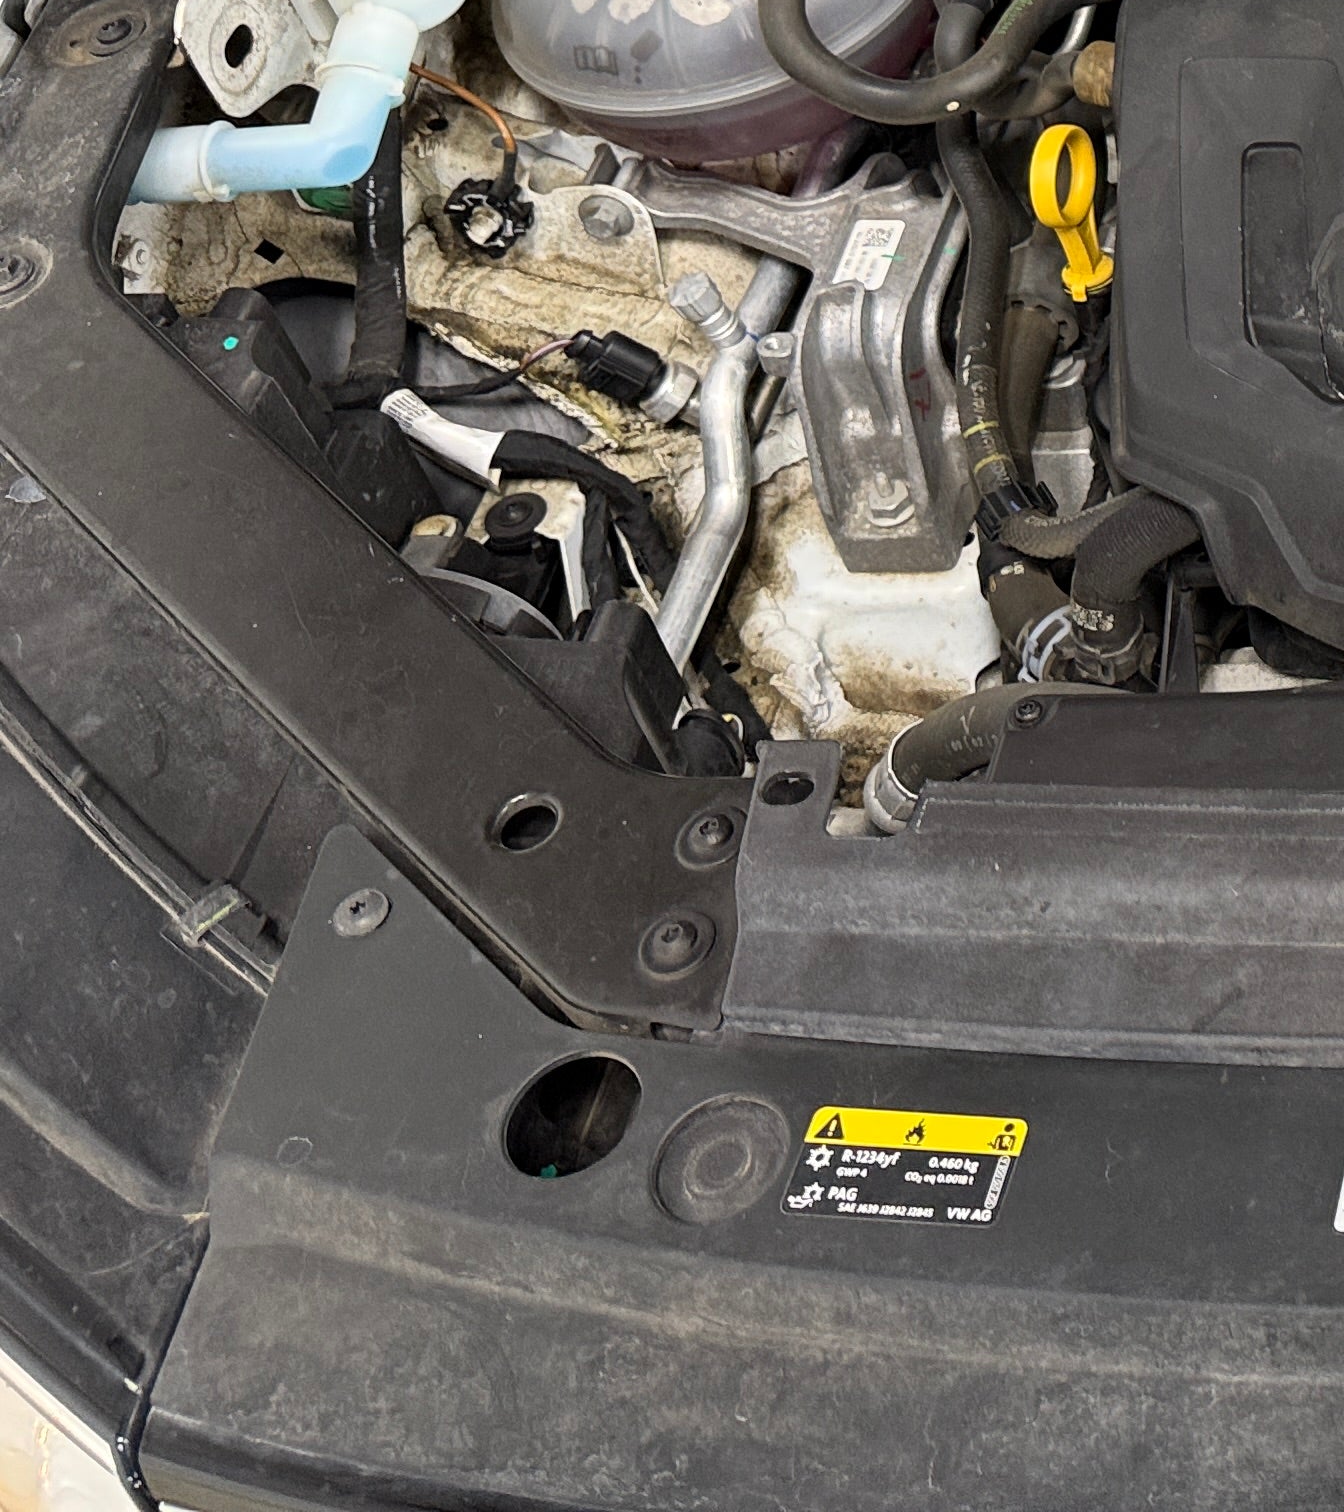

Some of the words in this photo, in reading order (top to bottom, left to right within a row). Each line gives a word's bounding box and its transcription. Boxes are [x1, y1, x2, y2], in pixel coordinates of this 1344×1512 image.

[840, 1148, 902, 1169] R-1234yf
[927, 1156, 963, 1170] 0.460
[963, 1158, 980, 1175] kg
[923, 1174, 937, 1186] eq
[826, 1185, 860, 1202] PAG
[836, 1201, 857, 1214] SAE
[946, 1206, 971, 1221] VW
[969, 1208, 993, 1222] AG
